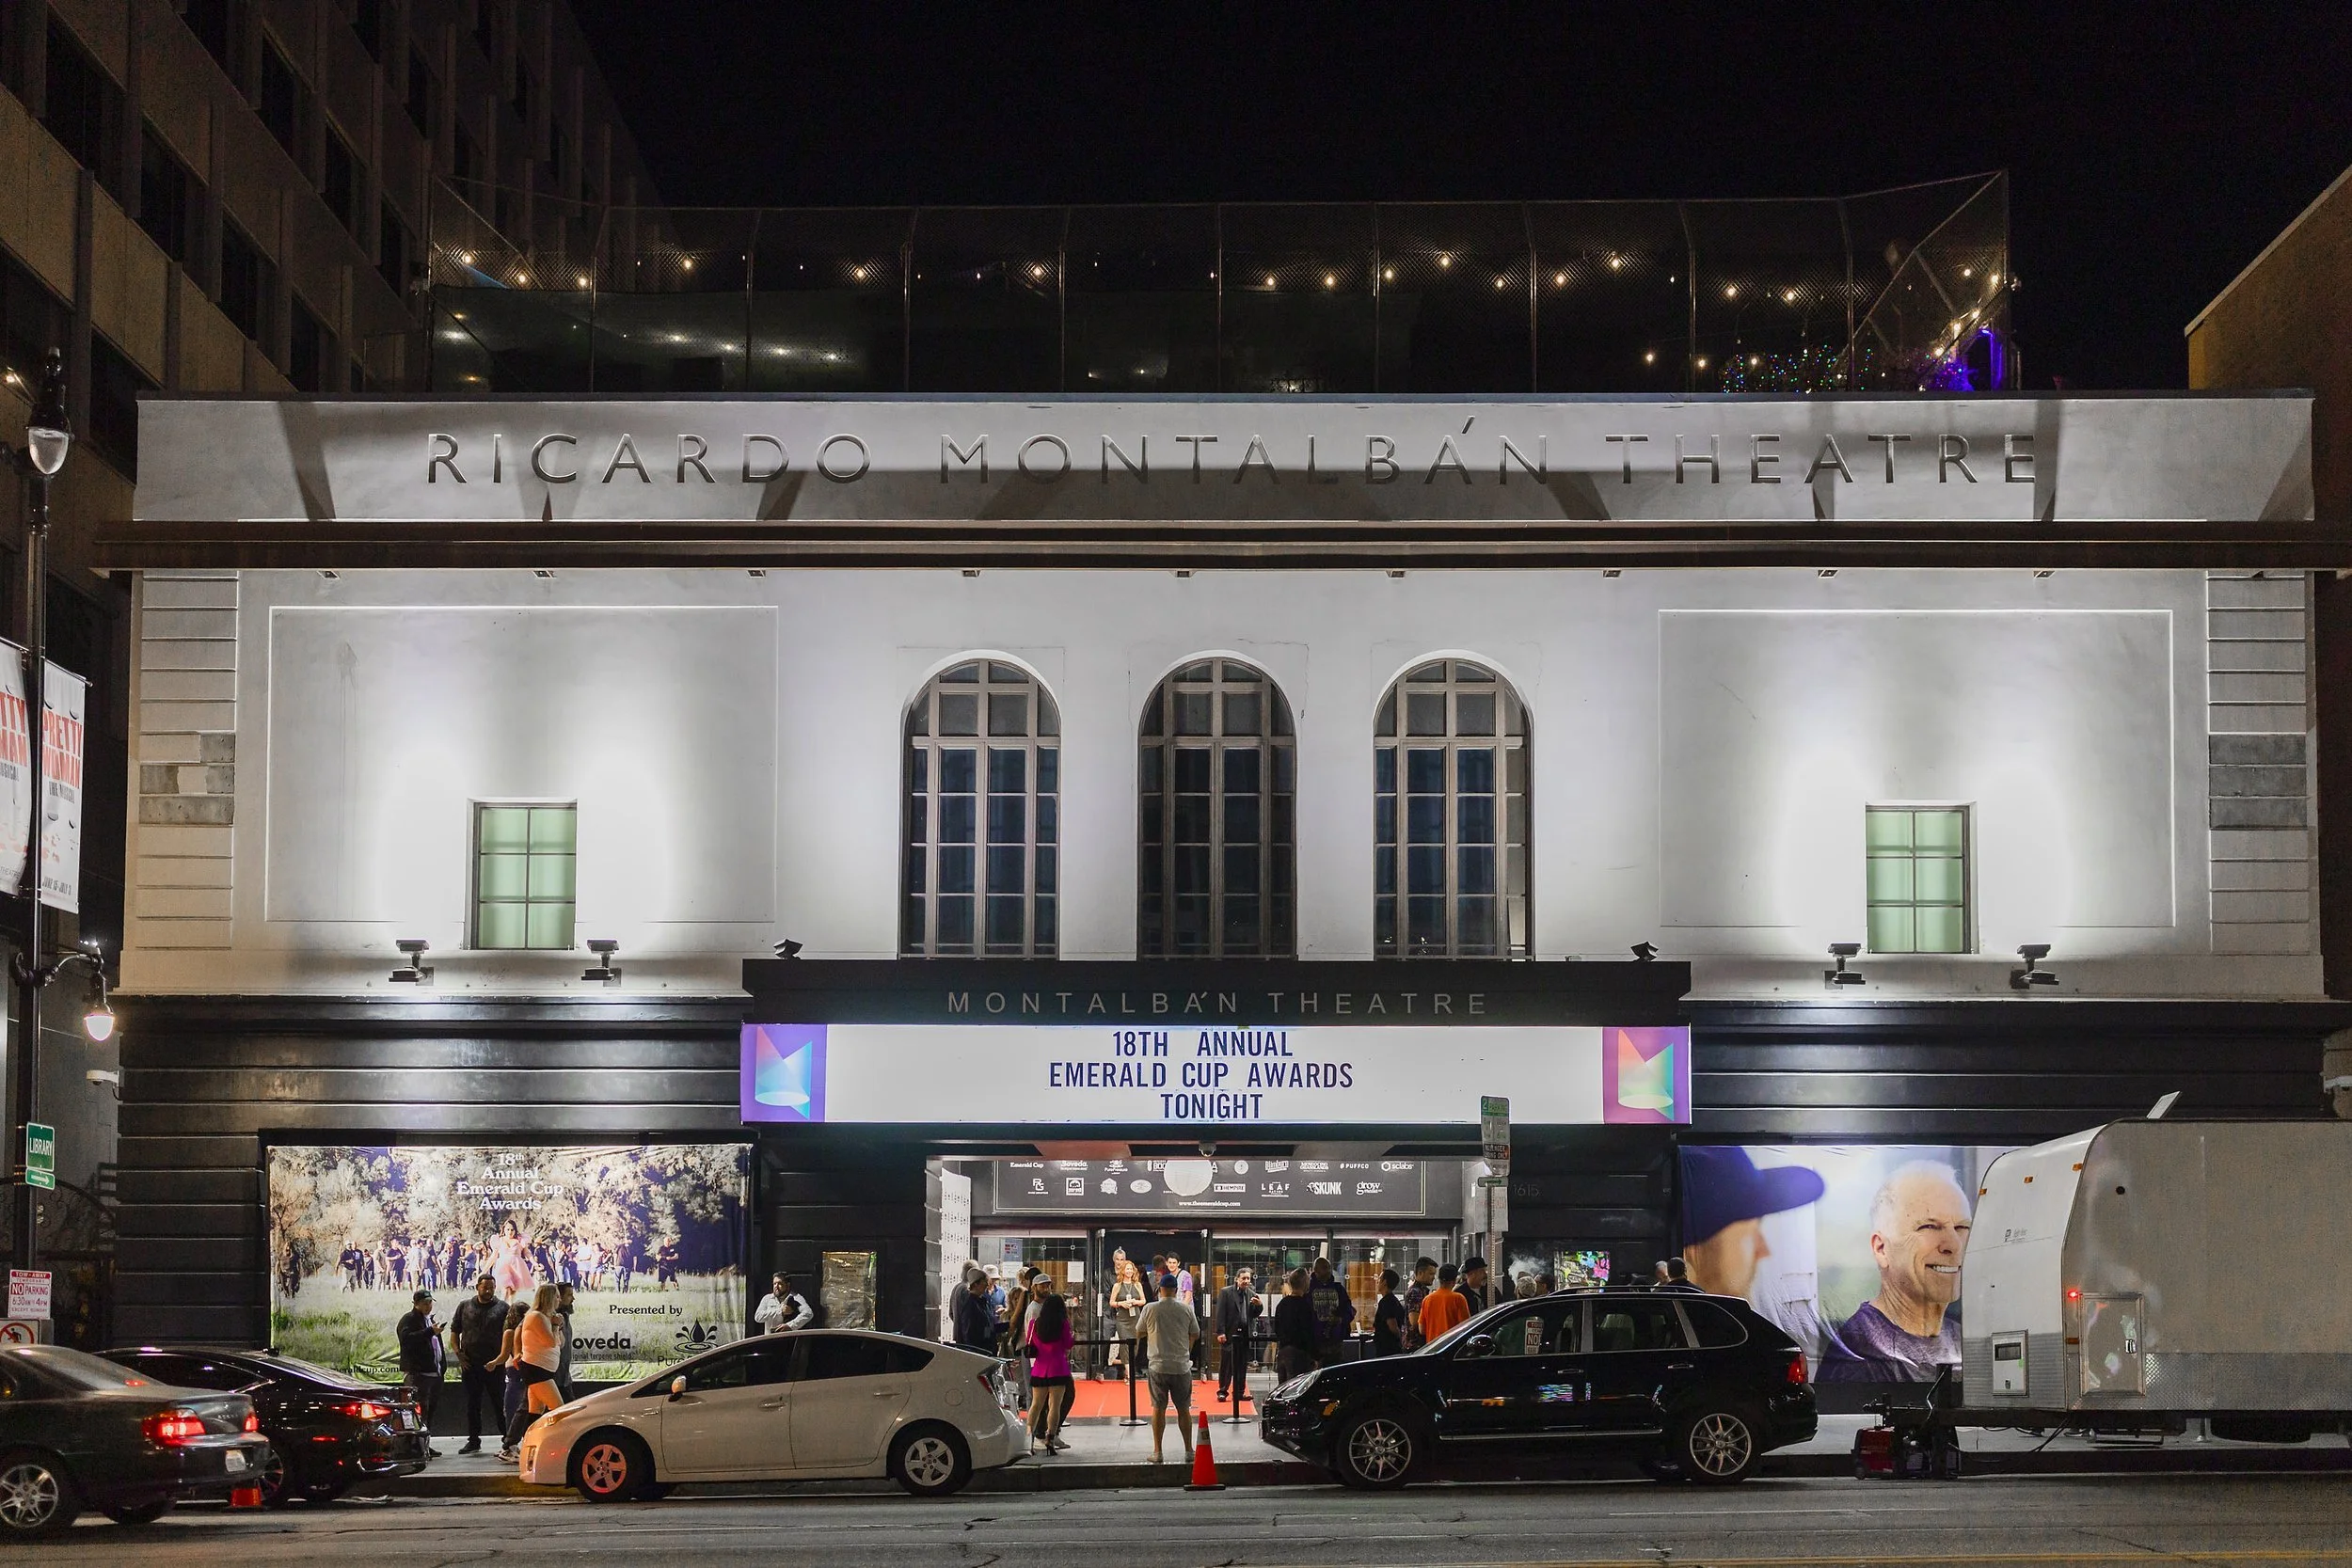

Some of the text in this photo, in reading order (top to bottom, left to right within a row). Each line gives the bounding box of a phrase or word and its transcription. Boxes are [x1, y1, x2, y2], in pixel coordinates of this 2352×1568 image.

[428, 416, 2036, 484] RICARDO MONTALBÁN THEATRE
[42, 707, 83, 758] PRETTY
[42, 744, 81, 789] WOMAN
[49, 781, 75, 804] THE MUSICAL
[948, 992, 1486, 1016] MONTALBÁN THEATRE
[1113, 1031, 1294, 1057] 18TH ANNUAL
[1050, 1062, 1353, 1088] EMERALD CUP AWARDS
[1160, 1093, 1263, 1119] TONIGHT
[29, 1136, 53, 1157] LIBRARY
[499, 1152, 524, 1165] 18th
[481, 1166, 539, 1180] Annual
[456, 1180, 564, 1197] Emerald Cup
[1314, 1181, 1343, 1196] SKUNK
[1357, 1180, 1381, 1196] grow
[479, 1196, 542, 1211] Awards
[11, 1283, 49, 1295] NO PARKING
[609, 1305, 683, 1317] Presented by
[572, 1332, 631, 1350] oveda
